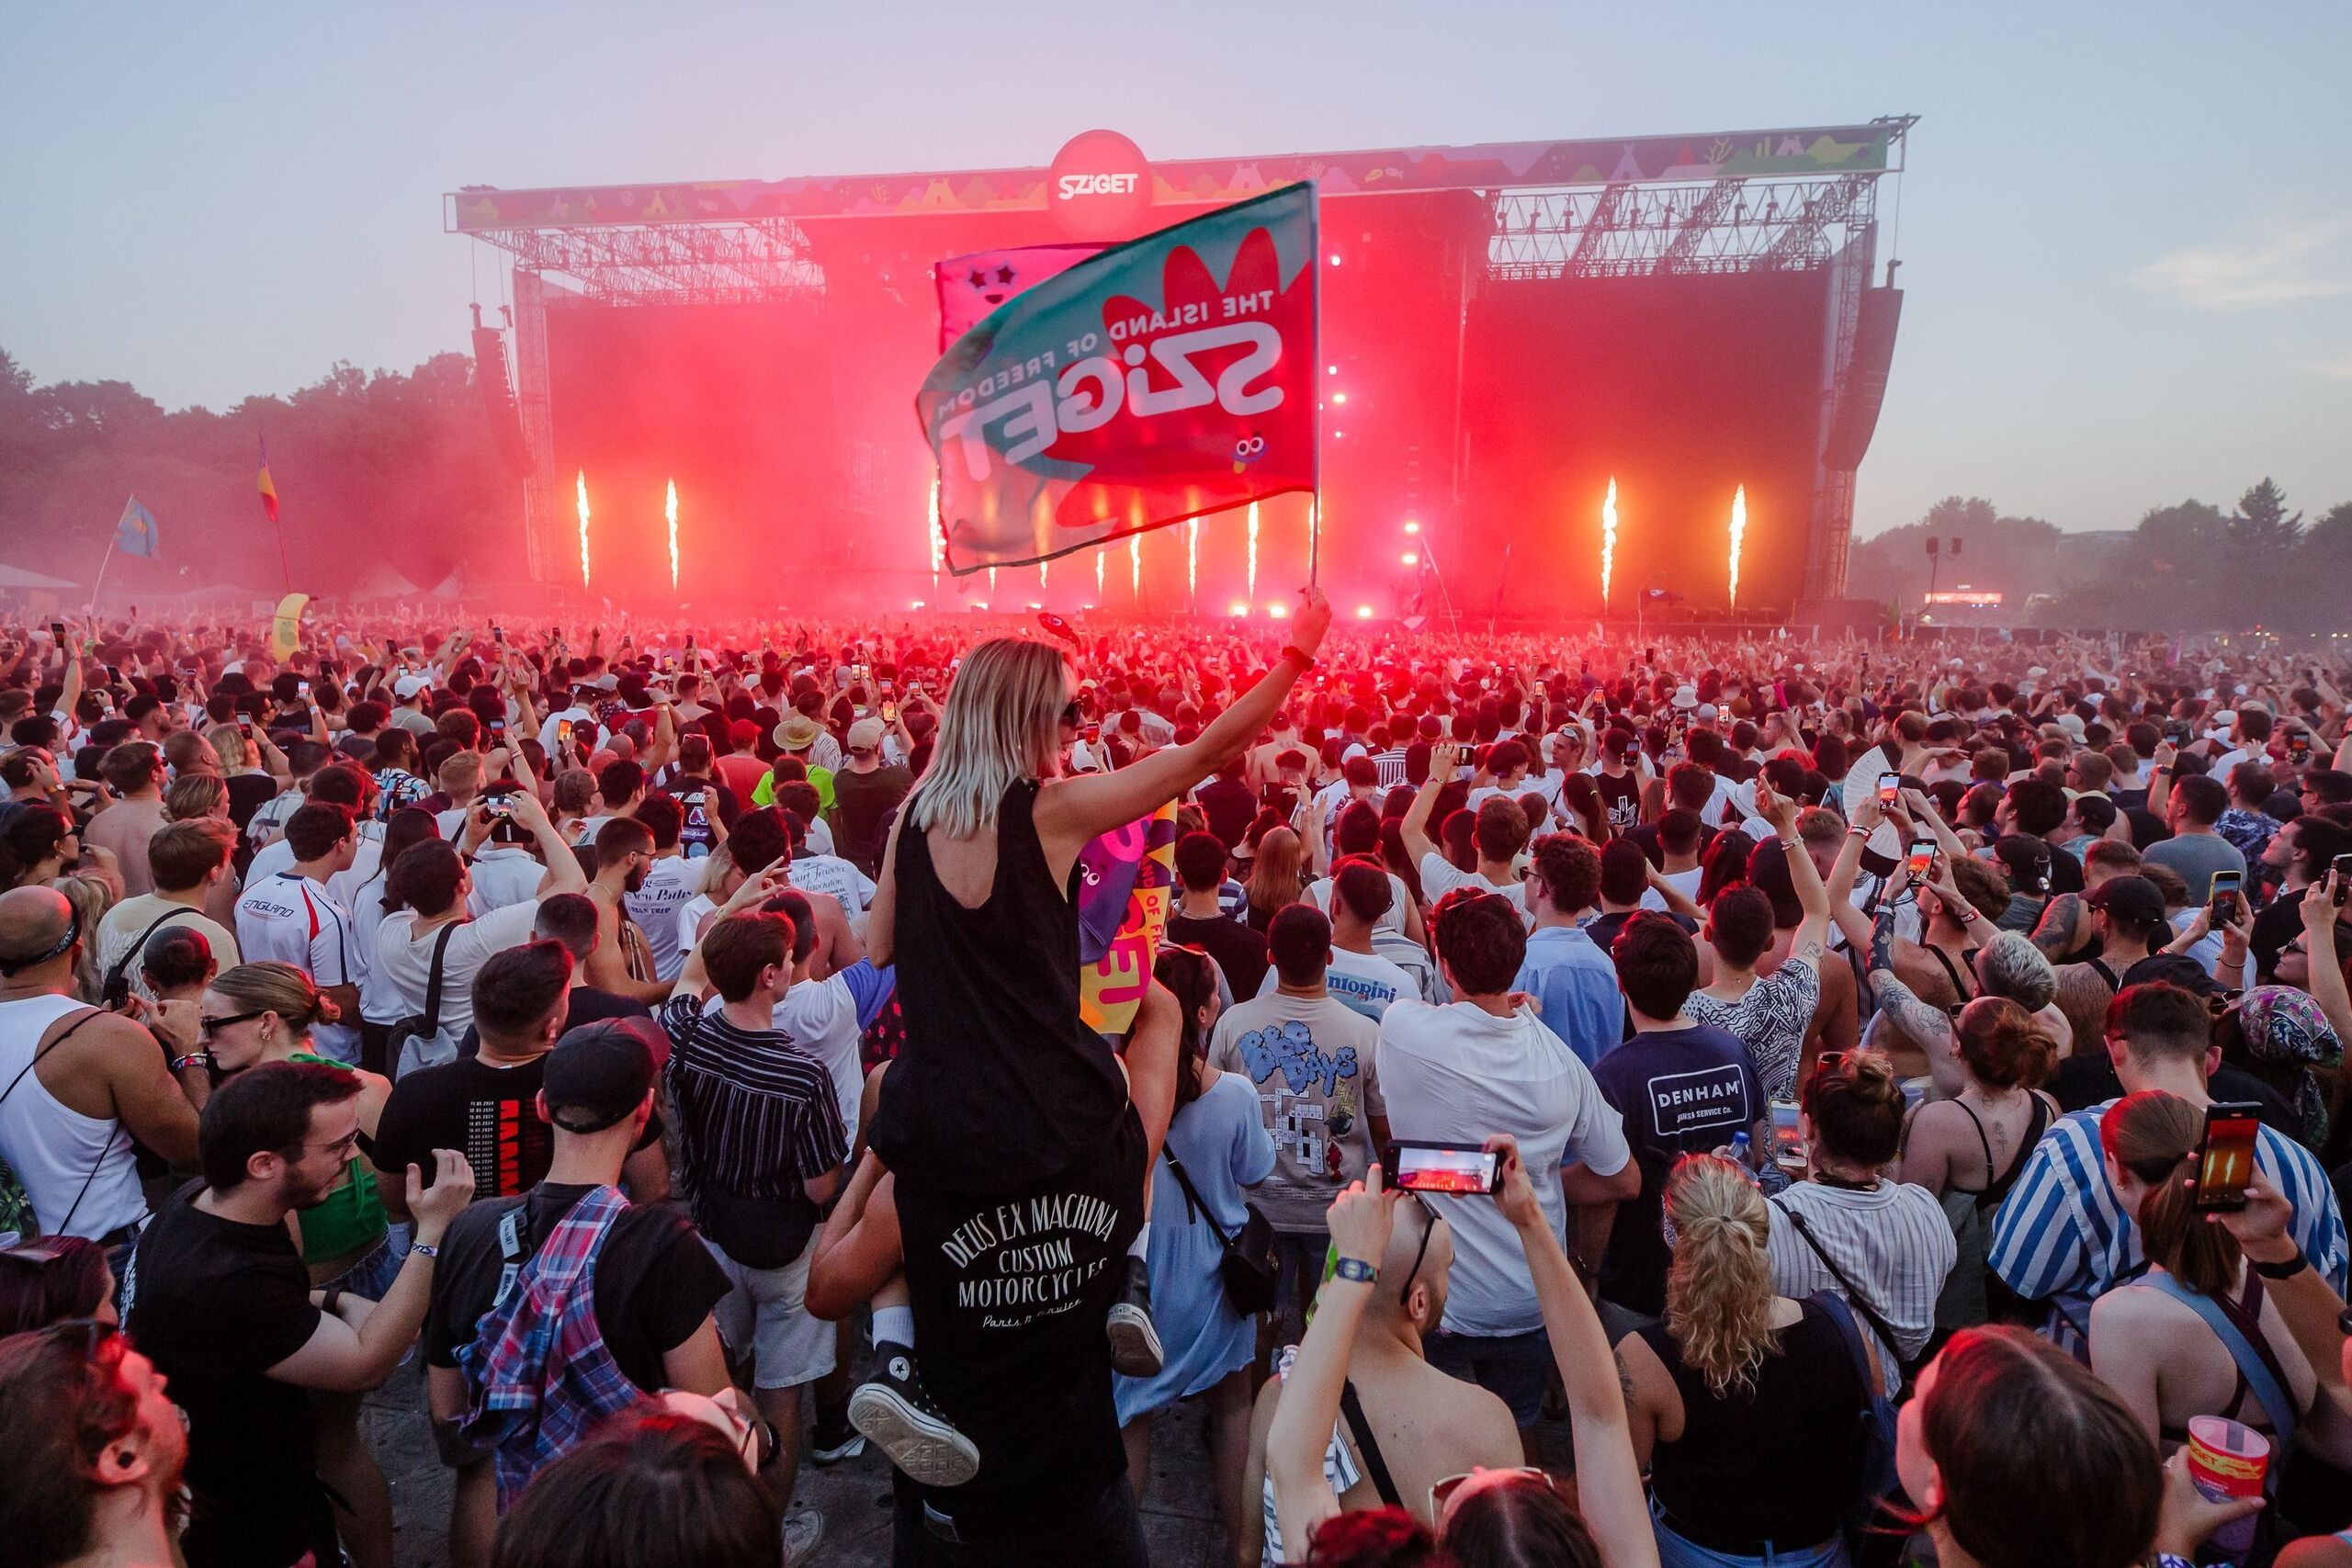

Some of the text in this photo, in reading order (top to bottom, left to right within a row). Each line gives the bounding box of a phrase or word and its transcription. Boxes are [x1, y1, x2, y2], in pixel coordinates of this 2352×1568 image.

[1058, 173, 1139, 200] SZiGET
[243, 900, 294, 917] ENGLAND
[1146, 896, 1160, 916] OF
[1328, 976, 1396, 1004] ntorini
[1658, 1080, 1739, 1107] DENHAM
[1697, 1108, 1722, 1118] SERVICE
[941, 1193, 1118, 1269] DEUS EX MACHINA
[999, 1237, 1074, 1274] CUSTOM
[982, 1314, 1023, 1328] Parts
[1036, 1299, 1082, 1316] ervice
